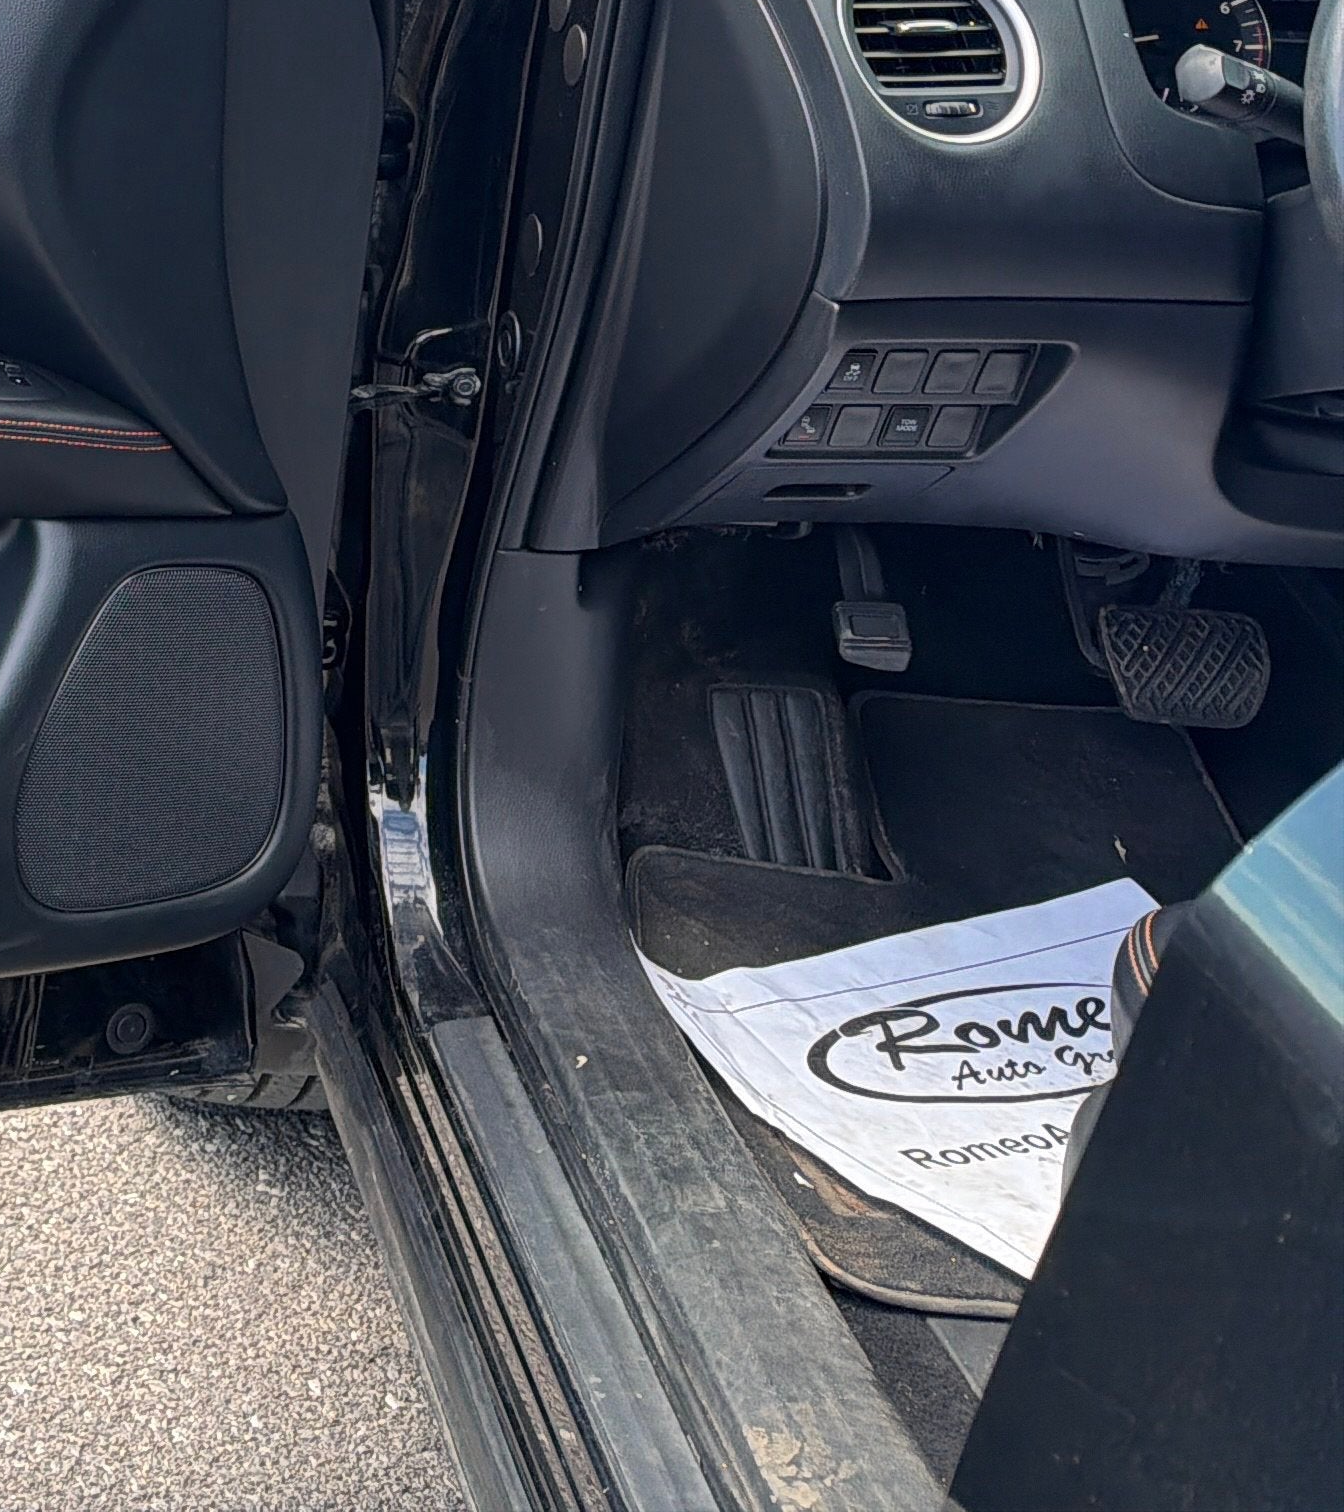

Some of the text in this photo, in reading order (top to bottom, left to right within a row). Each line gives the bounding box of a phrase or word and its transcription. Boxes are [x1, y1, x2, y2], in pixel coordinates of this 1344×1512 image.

[1220, 1, 1230, 14] 6
[1233, 39, 1243, 52] 7
[839, 995, 1111, 1072] Rome
[951, 1058, 1047, 1091] Auto
[899, 1122, 1072, 1171] RomeoA
